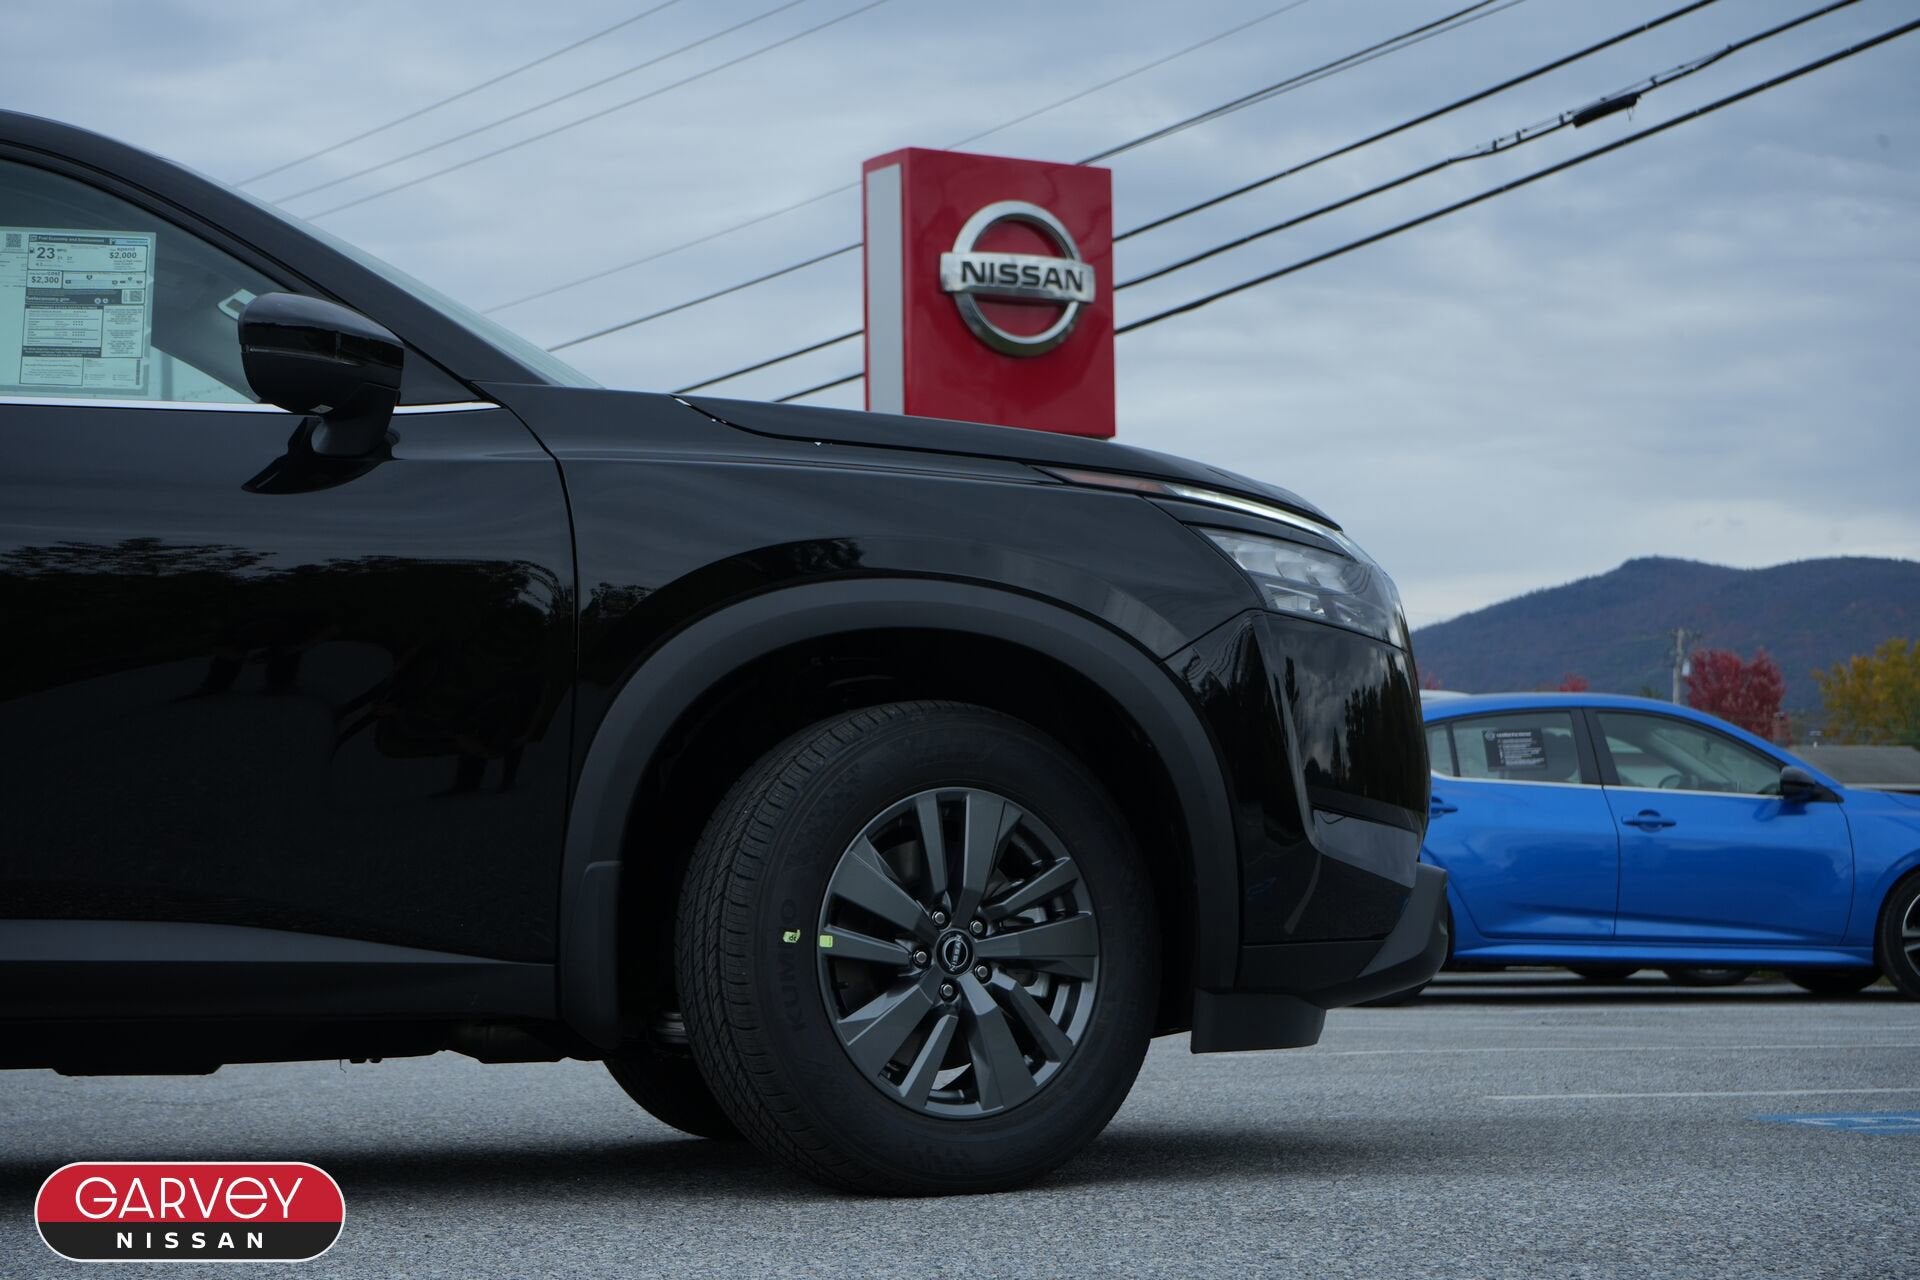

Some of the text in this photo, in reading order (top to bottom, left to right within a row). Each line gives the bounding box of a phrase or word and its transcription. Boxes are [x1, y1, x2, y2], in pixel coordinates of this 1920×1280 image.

[36, 247, 55, 259] 23
[31, 276, 60, 284] $2,300
[961, 261, 1084, 292] NISSAN
[777, 898, 807, 1033] KUMO
